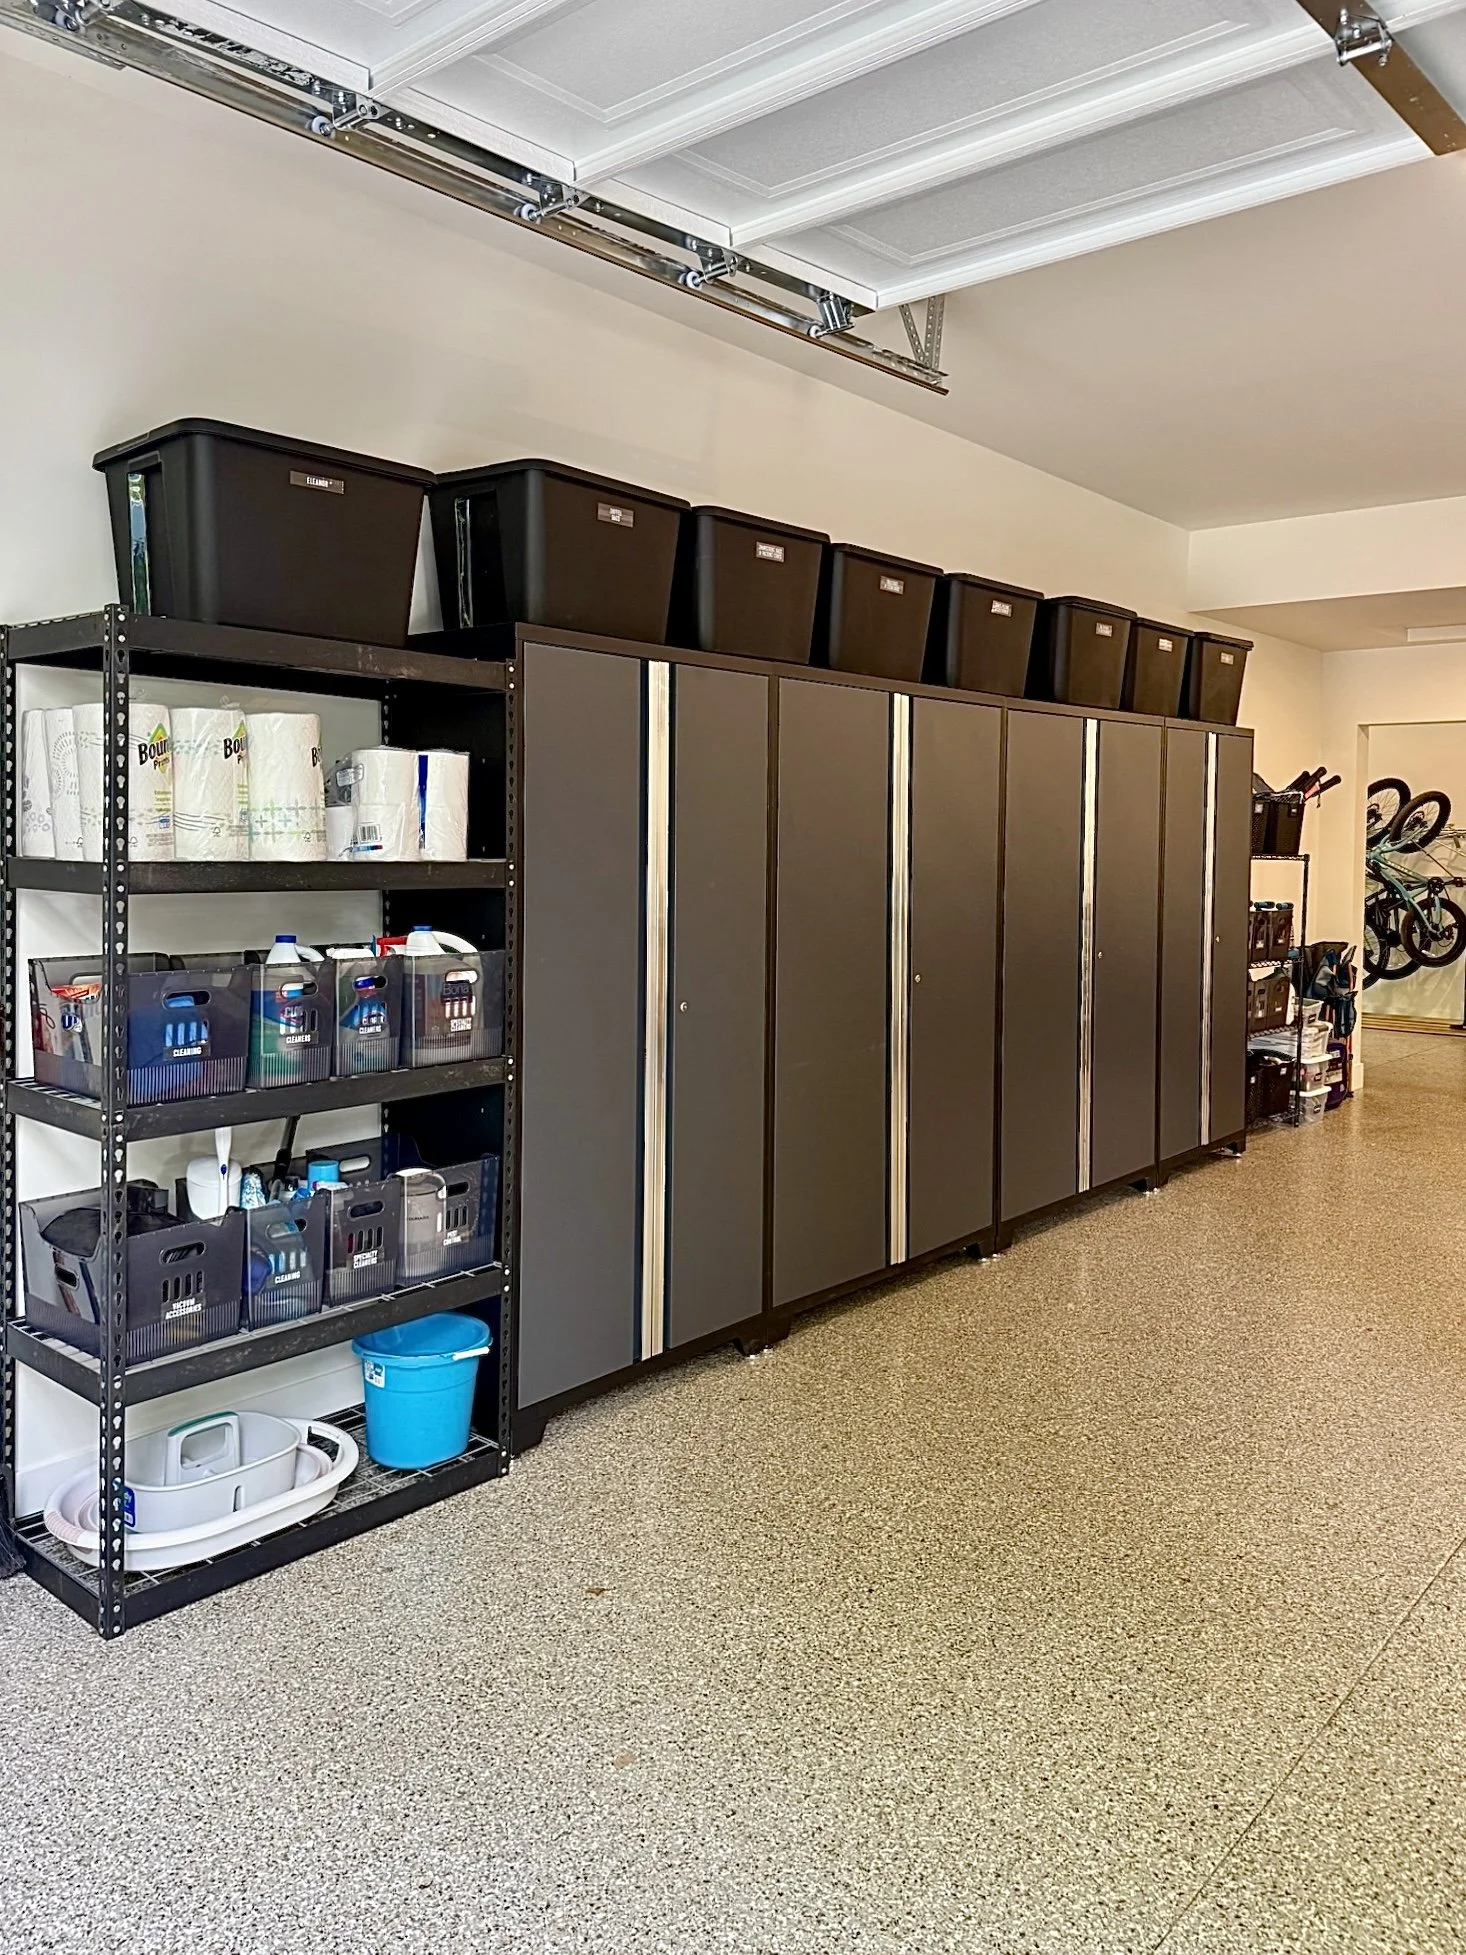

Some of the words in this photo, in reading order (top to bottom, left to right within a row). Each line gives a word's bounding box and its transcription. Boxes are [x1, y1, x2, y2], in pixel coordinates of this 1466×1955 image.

[443, 983, 470, 995] Bona
[359, 1024, 382, 1035] CLEANERS
[450, 1023, 472, 1033] CLEANERS
[286, 1034, 311, 1044] CLEANERS
[173, 1046, 202, 1057] CLEANING
[353, 1250, 378, 1262] SPECIALTY
[353, 1256, 378, 1269] CLEANERS
[275, 1270, 301, 1285] CLEANING
[172, 1297, 196, 1310] VACUUM
[165, 1303, 202, 1320] ACCESSORIES
